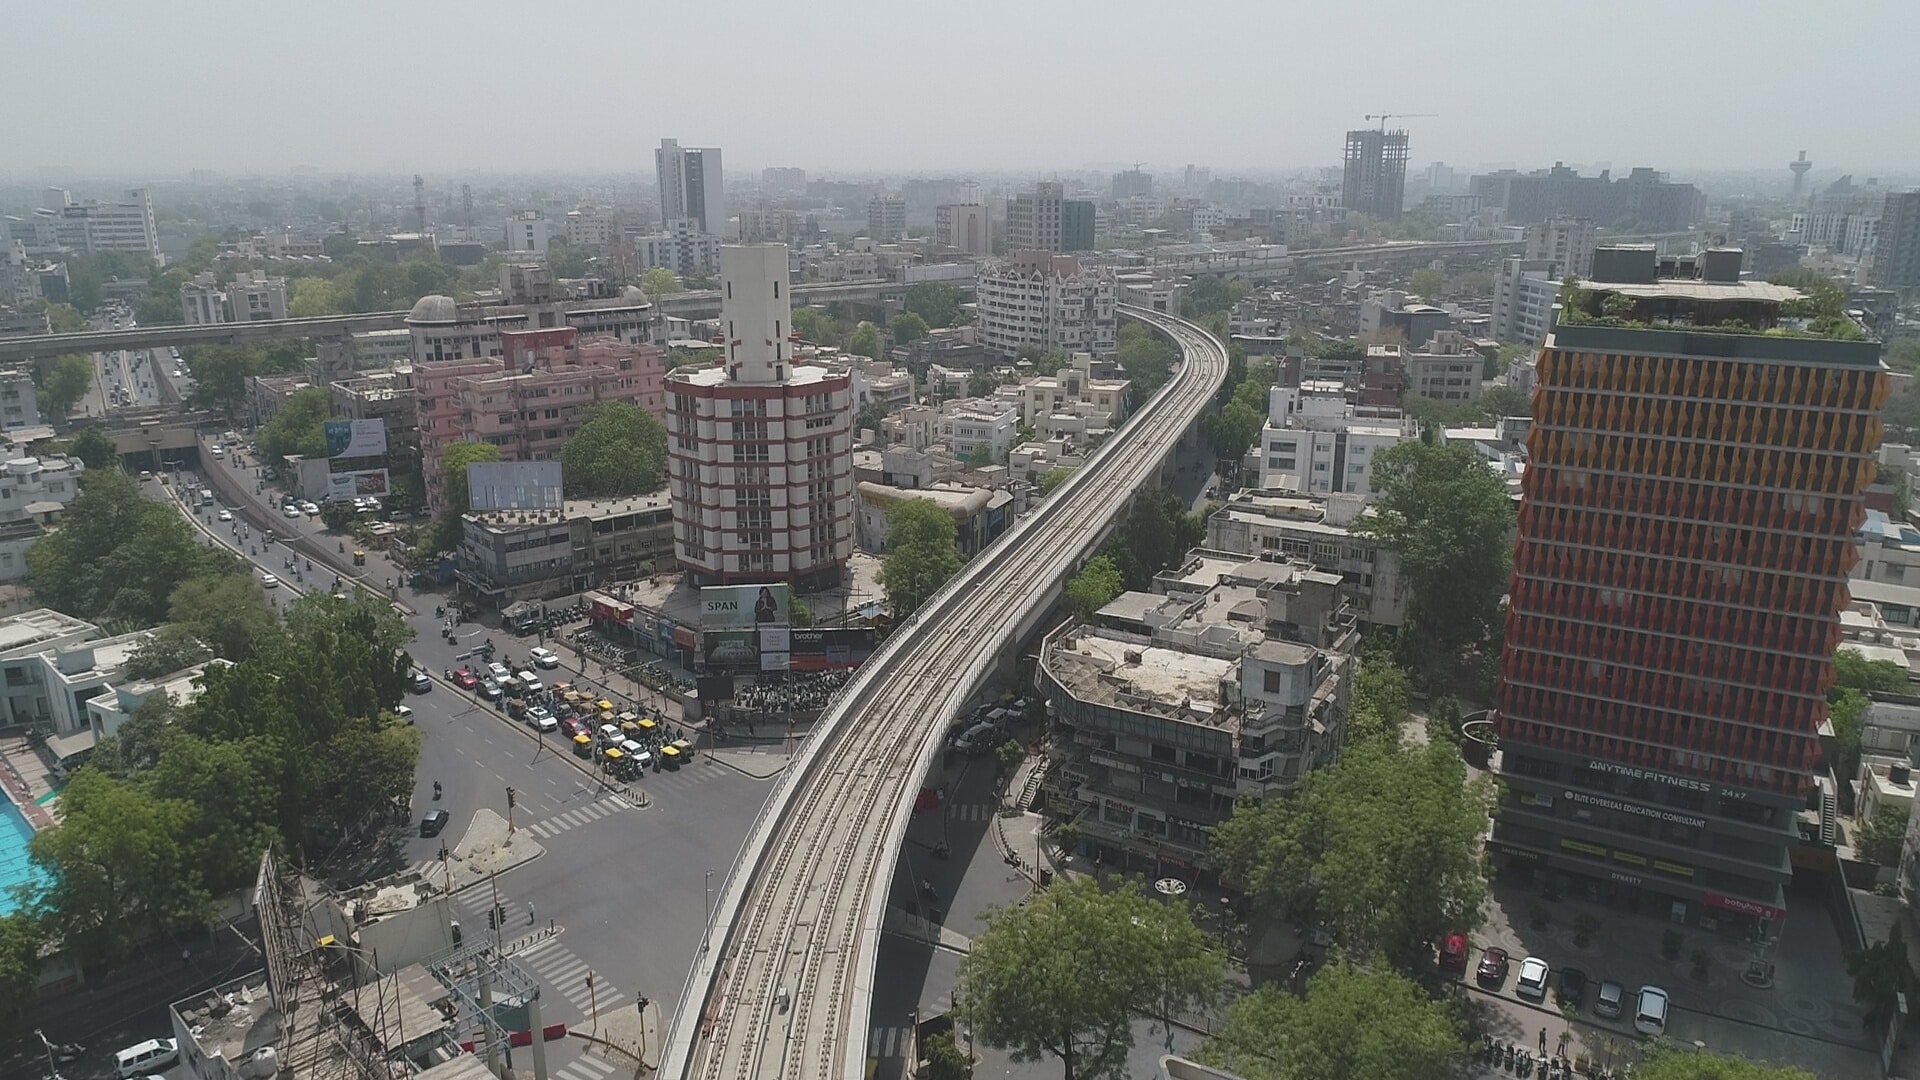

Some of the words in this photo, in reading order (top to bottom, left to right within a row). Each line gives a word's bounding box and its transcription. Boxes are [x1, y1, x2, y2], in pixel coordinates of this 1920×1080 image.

[707, 601, 738, 611] SPAN
[794, 632, 823, 640] brother
[1589, 760, 1642, 778] ANYTIME
[1644, 771, 1711, 792] FITNESS
[1721, 788, 1747, 800] 24x7
[1574, 793, 1590, 803] ELITE
[1590, 797, 1622, 811] OVERSEAS
[1623, 804, 1662, 820] EDUCATION
[1662, 812, 1706, 828] CONSULTANT
[1611, 872, 1642, 885] DYNASTY
